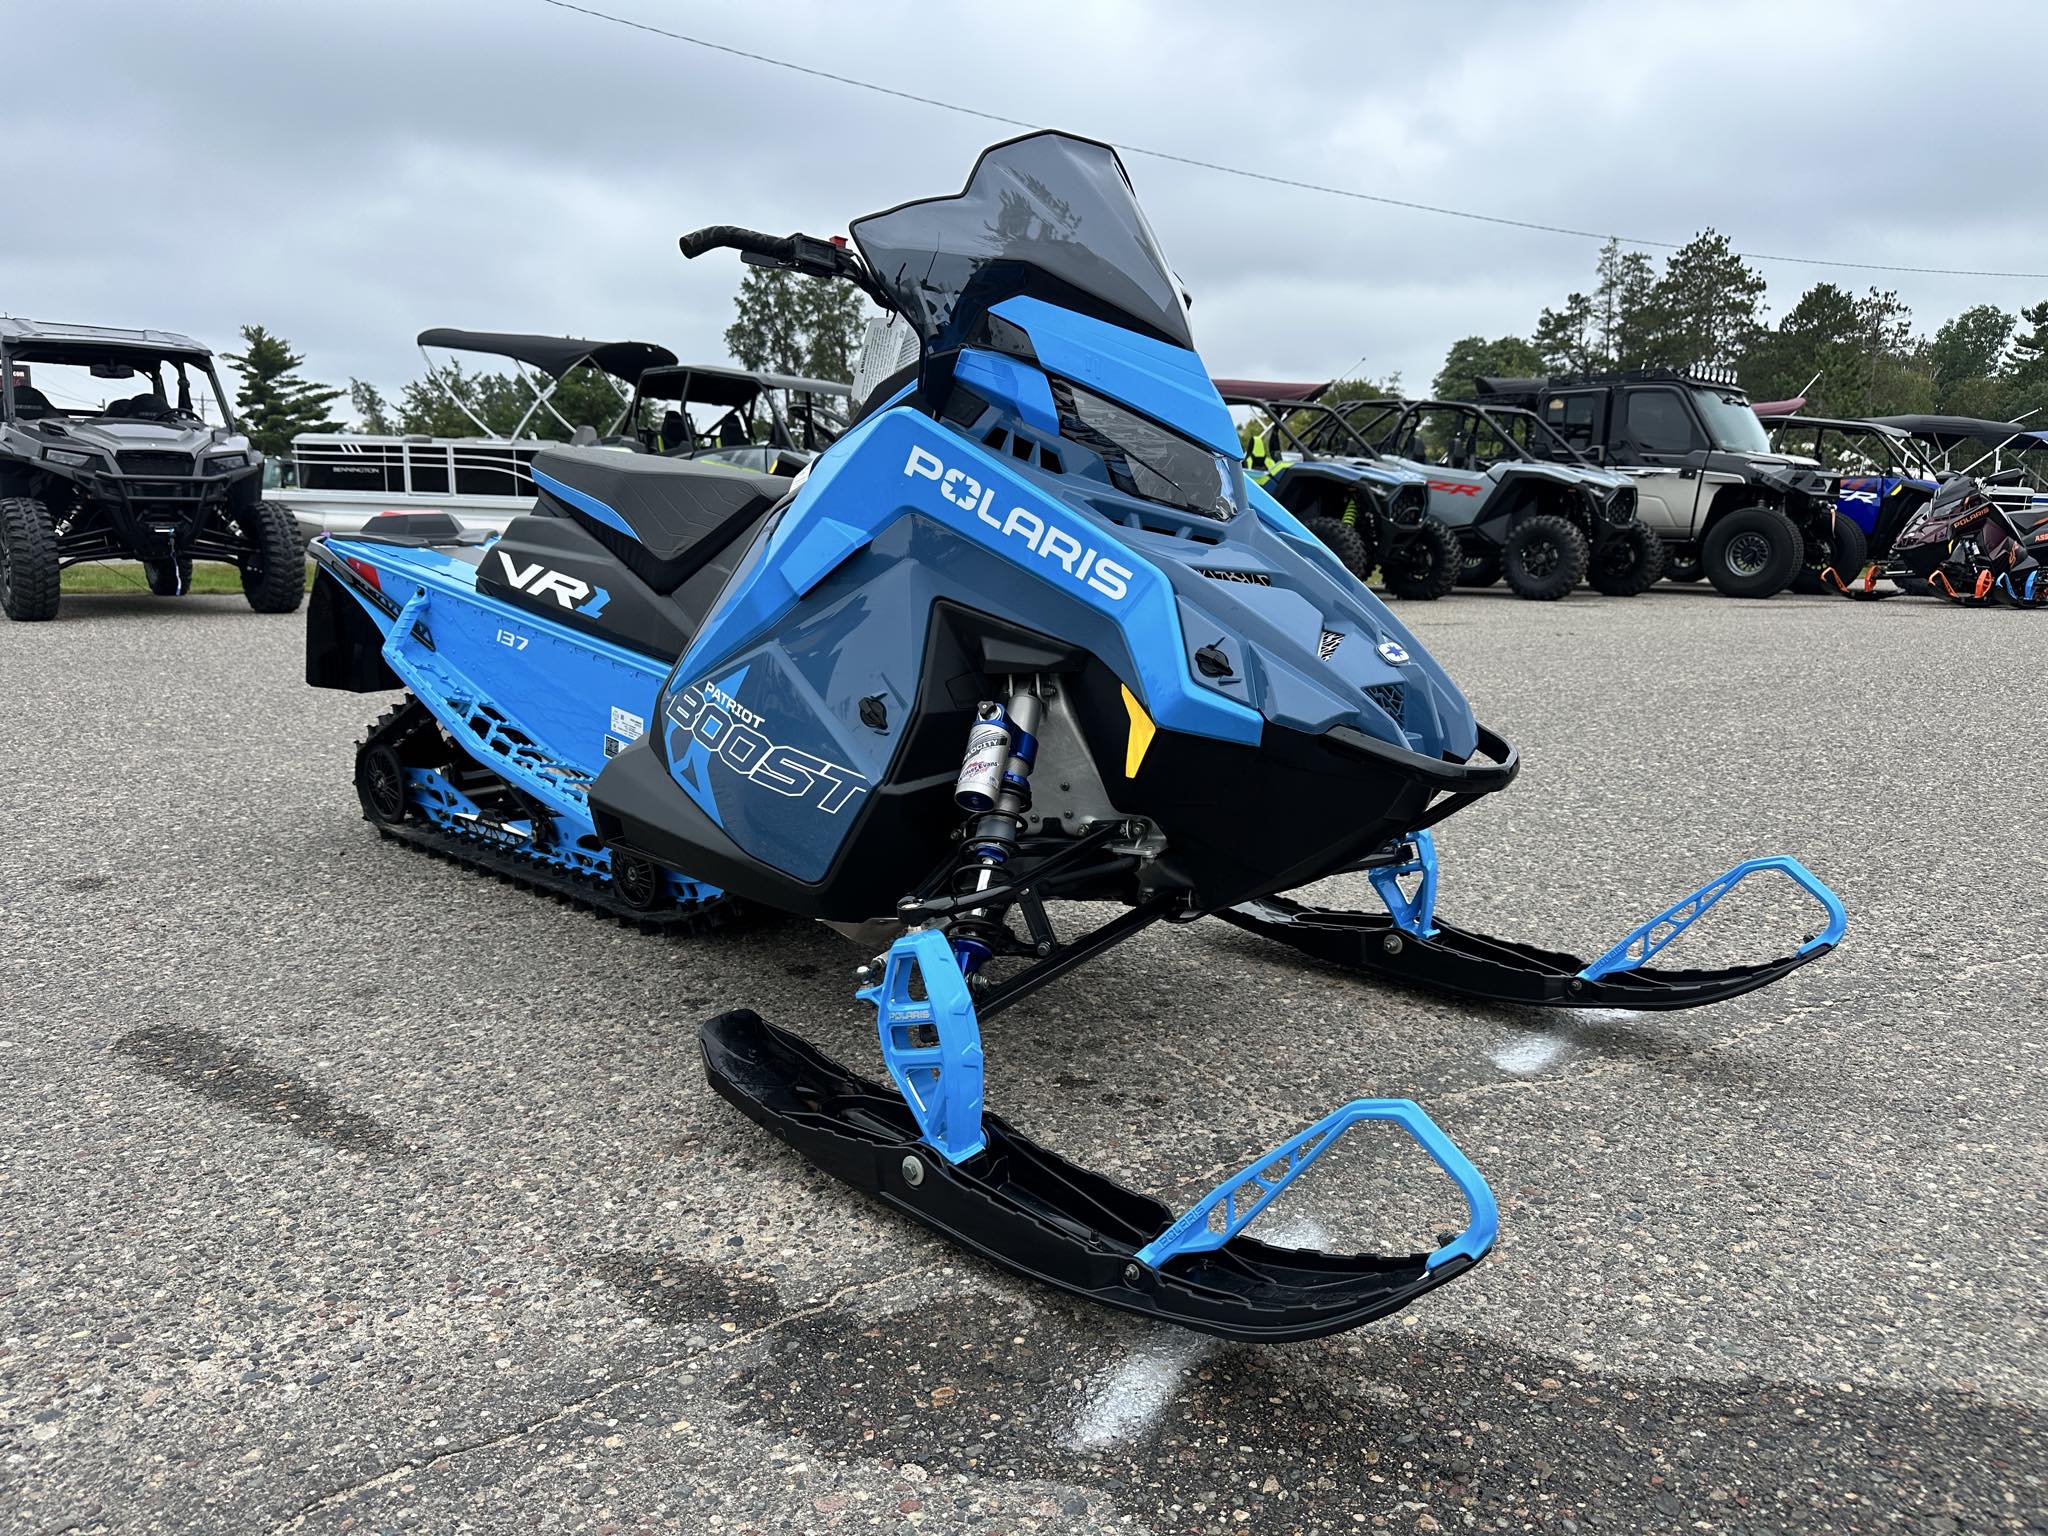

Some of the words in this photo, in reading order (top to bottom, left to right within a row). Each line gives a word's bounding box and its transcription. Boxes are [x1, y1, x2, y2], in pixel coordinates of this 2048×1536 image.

[904, 445, 1134, 600] POLARIS
[1953, 507, 1990, 529] POLARIS
[497, 550, 611, 619] VR1
[496, 629, 529, 651] 137
[704, 681, 765, 729] PATRIOT
[666, 685, 867, 814] BOOST
[1159, 1204, 1205, 1248] POLARIS
